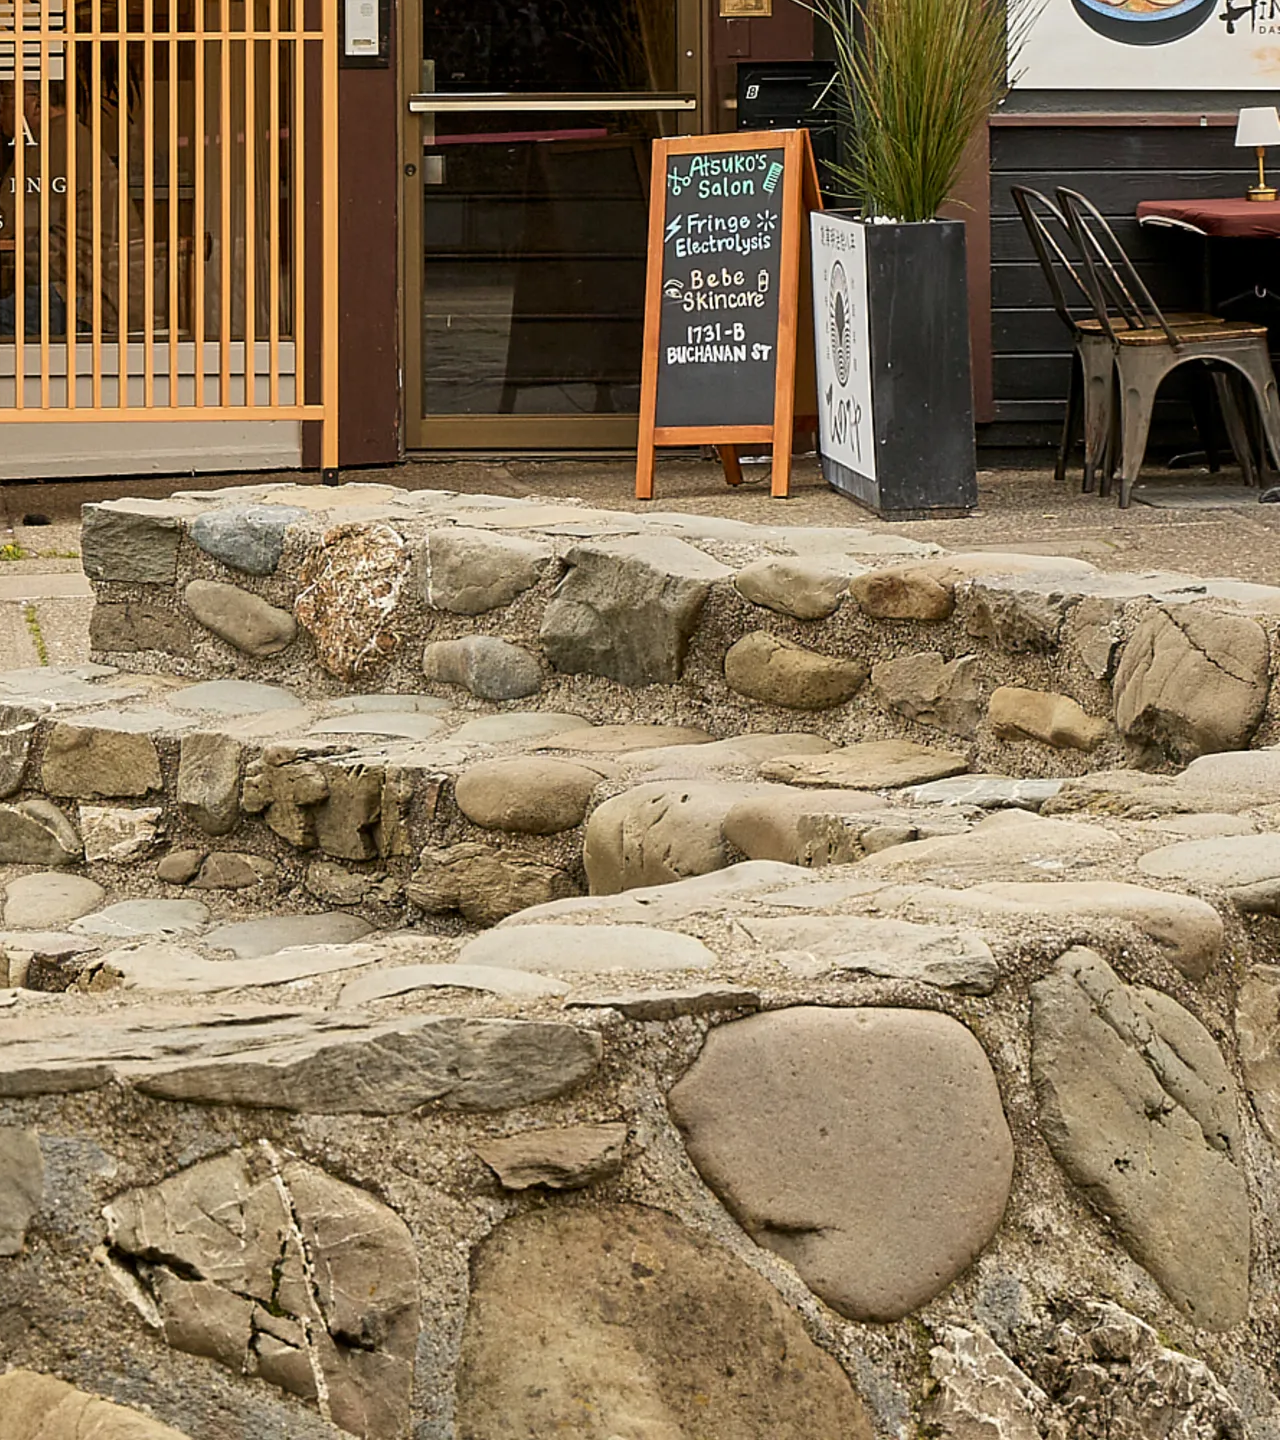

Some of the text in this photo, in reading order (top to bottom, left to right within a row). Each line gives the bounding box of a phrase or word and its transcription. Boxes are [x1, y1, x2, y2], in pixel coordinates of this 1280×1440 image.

[698, 177, 755, 198] Salon
[687, 214, 751, 234] Fringe
[676, 232, 771, 257] Electrolysis
[690, 267, 745, 289] Bebe
[683, 291, 765, 312] Skincare
[667, 343, 772, 364] BUCHANAN ST
